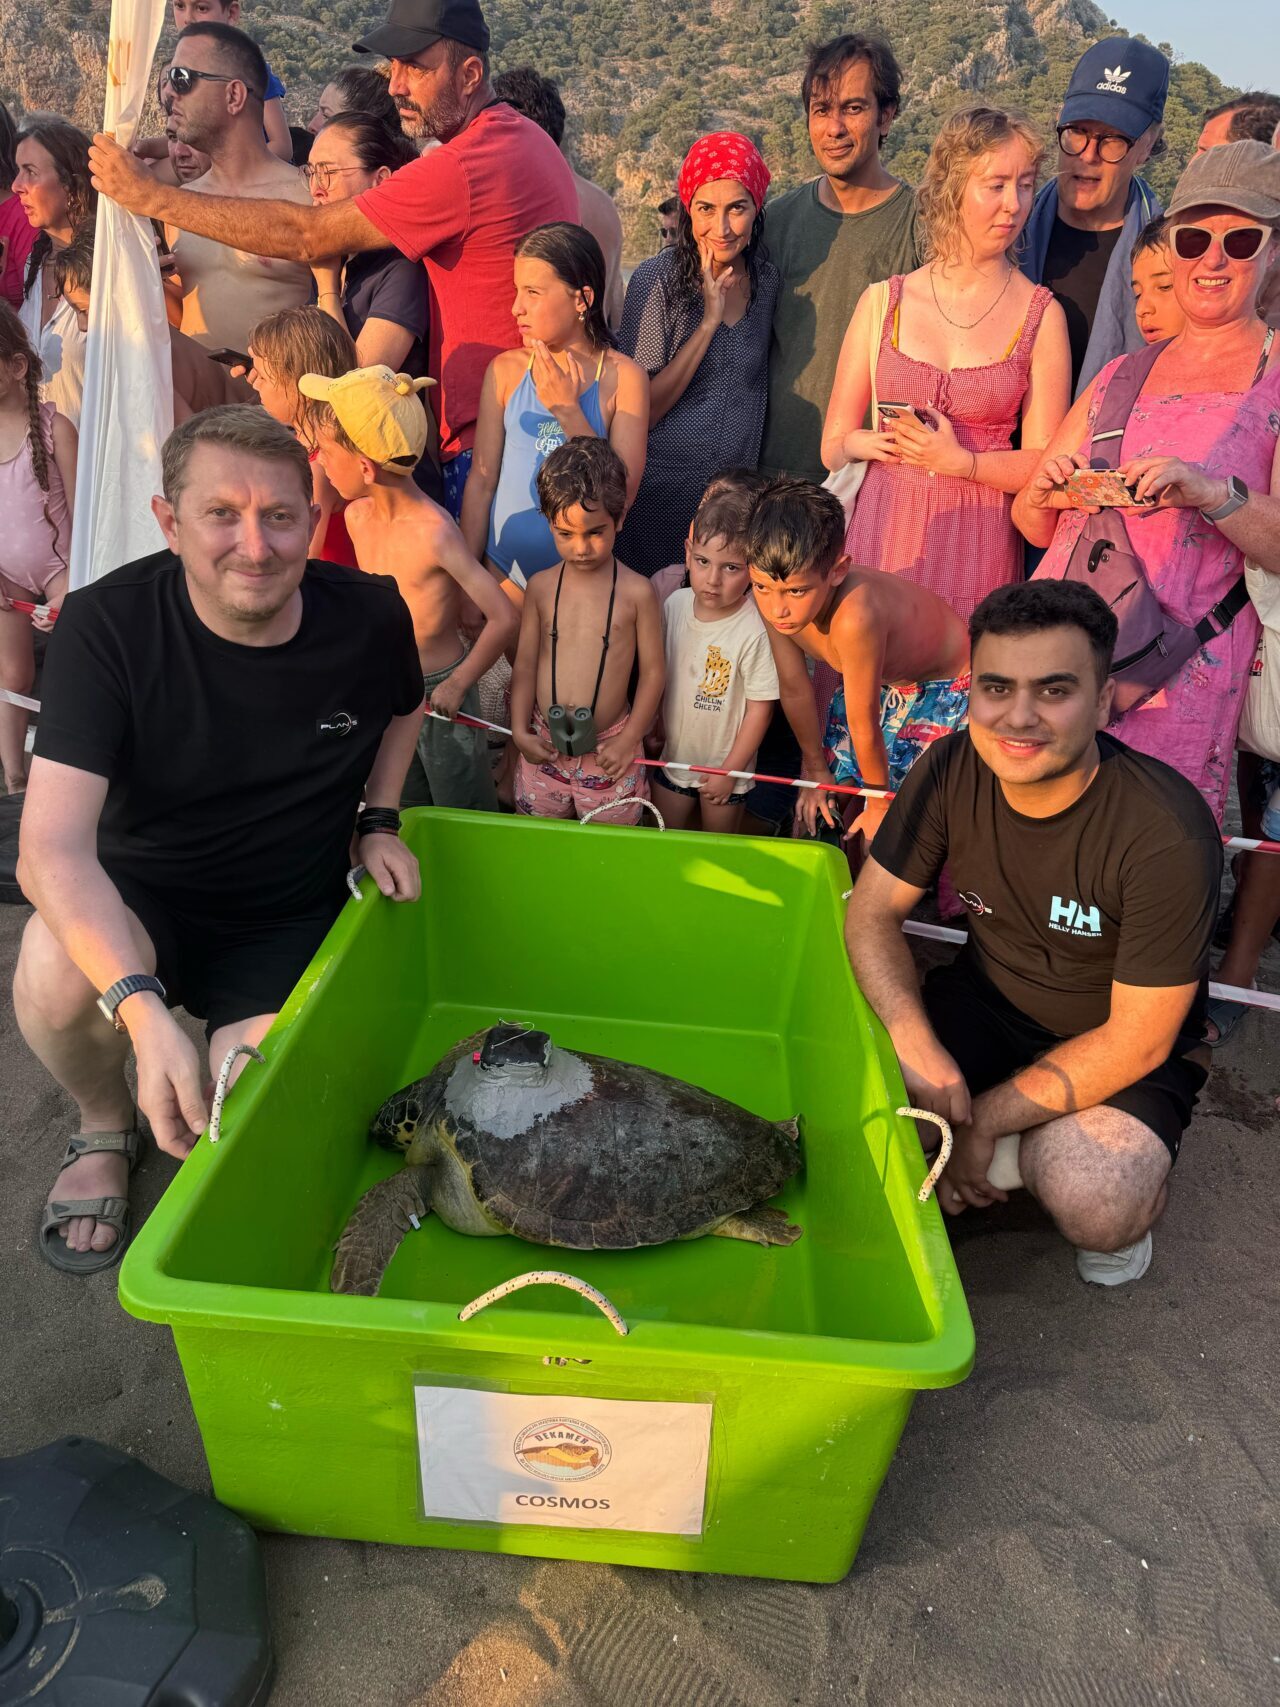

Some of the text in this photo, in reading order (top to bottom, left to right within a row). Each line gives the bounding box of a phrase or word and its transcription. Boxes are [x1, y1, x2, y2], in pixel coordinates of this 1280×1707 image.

[1096, 81, 1127, 95] adidas
[695, 695, 726, 706] CHILLIN'
[1049, 895, 1102, 932] HH
[1048, 922, 1102, 937] HELLY HANSEN
[534, 1431, 589, 1445] DEKAMER
[515, 1494, 611, 1511] COSMOS
